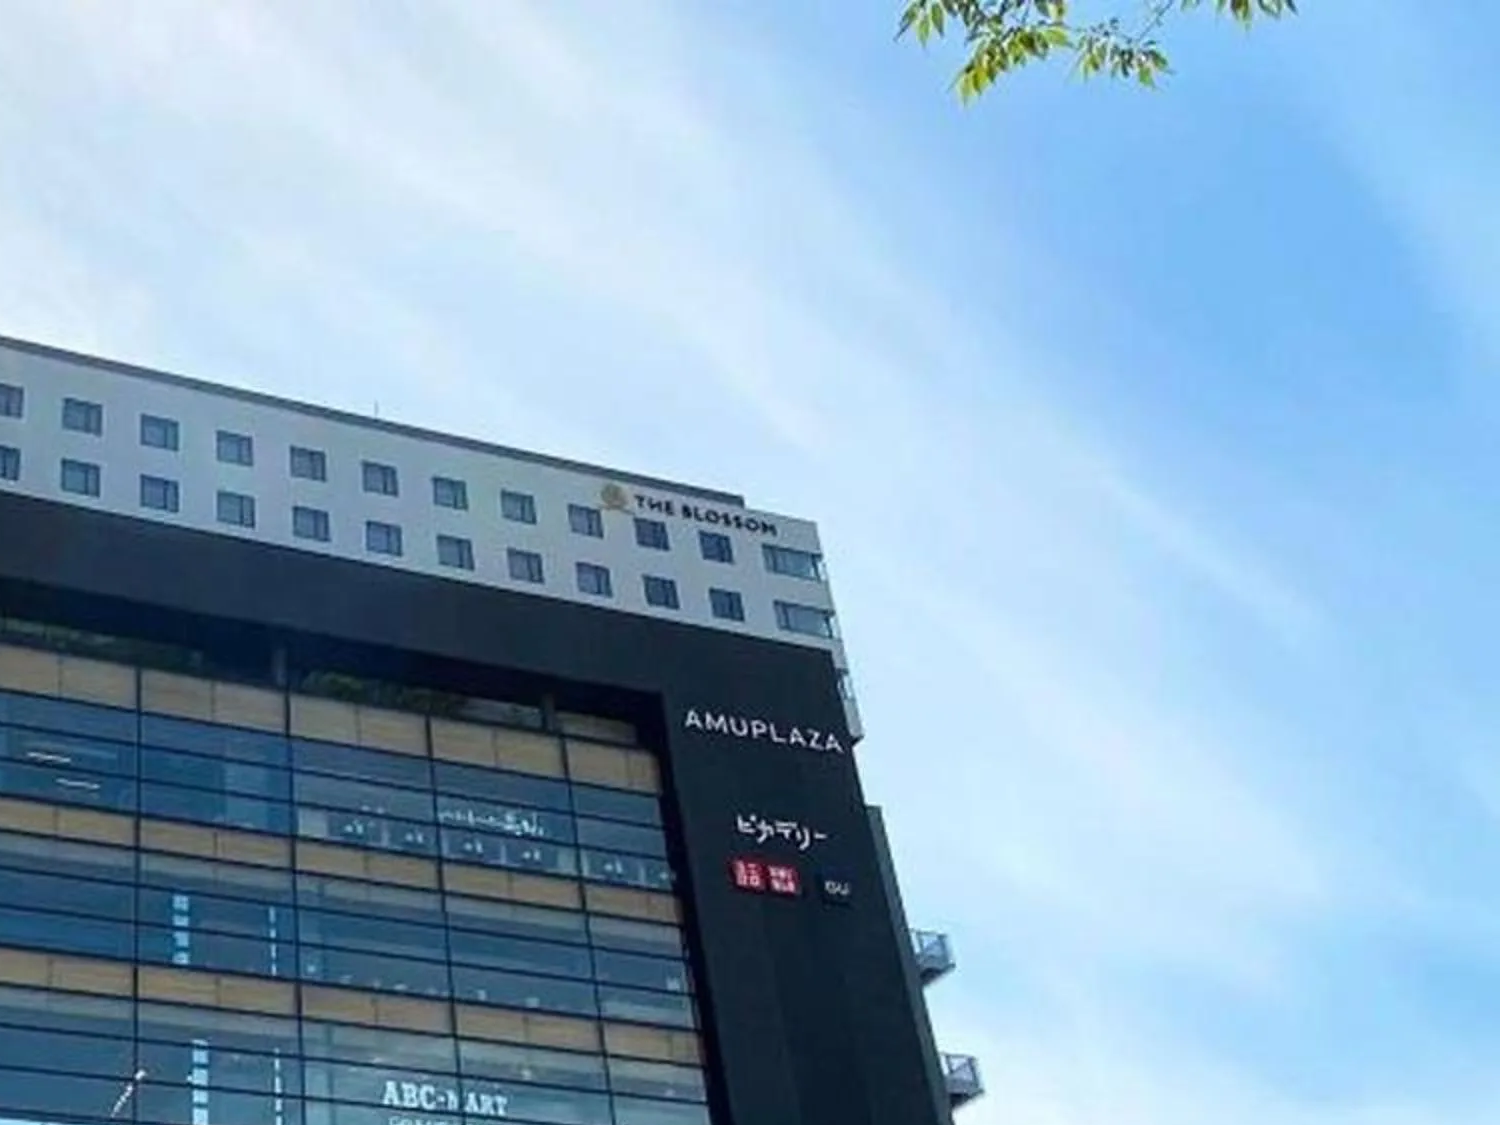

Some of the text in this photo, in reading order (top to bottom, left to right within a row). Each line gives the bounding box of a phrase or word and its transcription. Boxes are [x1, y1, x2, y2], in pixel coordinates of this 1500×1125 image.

[634, 495, 778, 536] THE BLOSSOM
[685, 710, 844, 753] AMUPLAZA
[737, 814, 828, 849] ピカデリー
